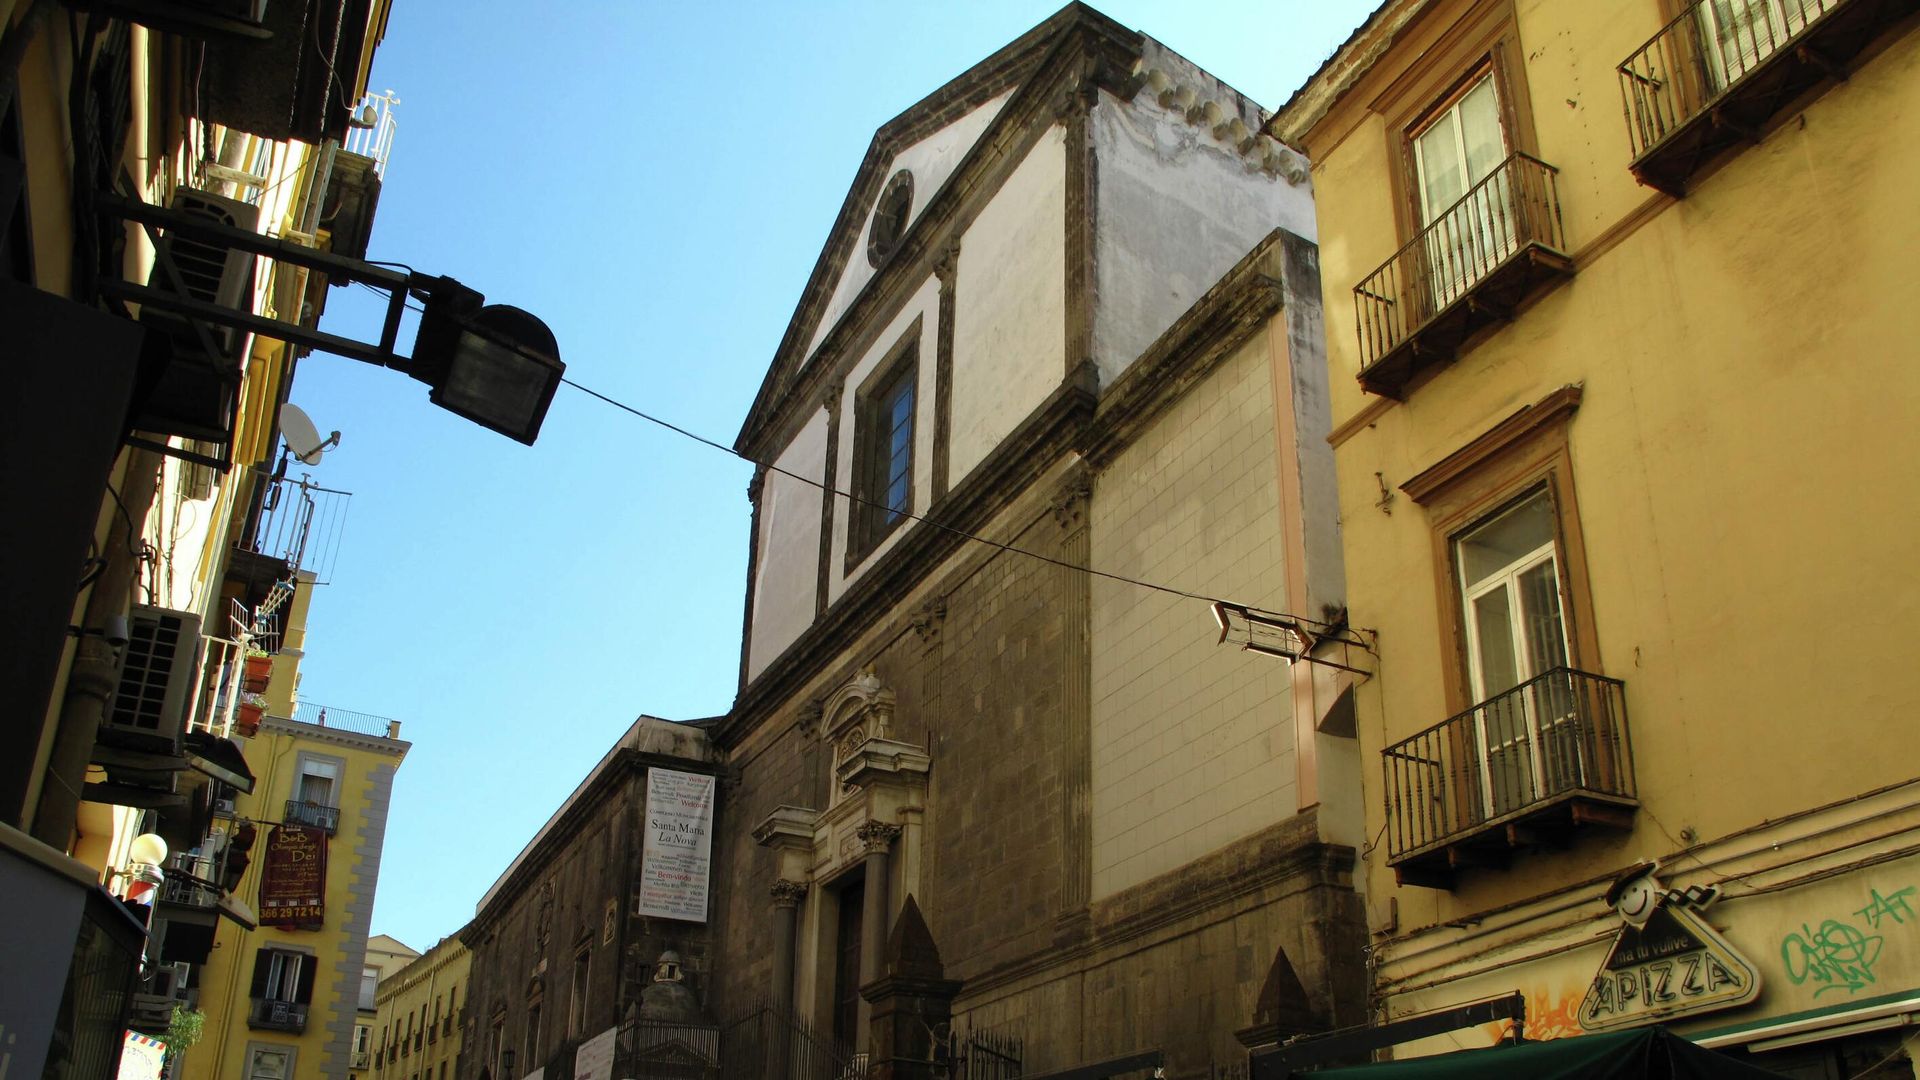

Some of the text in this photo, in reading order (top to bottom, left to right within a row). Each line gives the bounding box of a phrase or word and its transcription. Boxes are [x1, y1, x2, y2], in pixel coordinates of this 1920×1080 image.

[651, 819, 704, 836] Santa Maria
[658, 832, 671, 842] La
[673, 834, 697, 846] Nova
[657, 871, 692, 881] Bem-vindo
[279, 907, 292, 918] 29
[294, 907, 307, 917] 72
